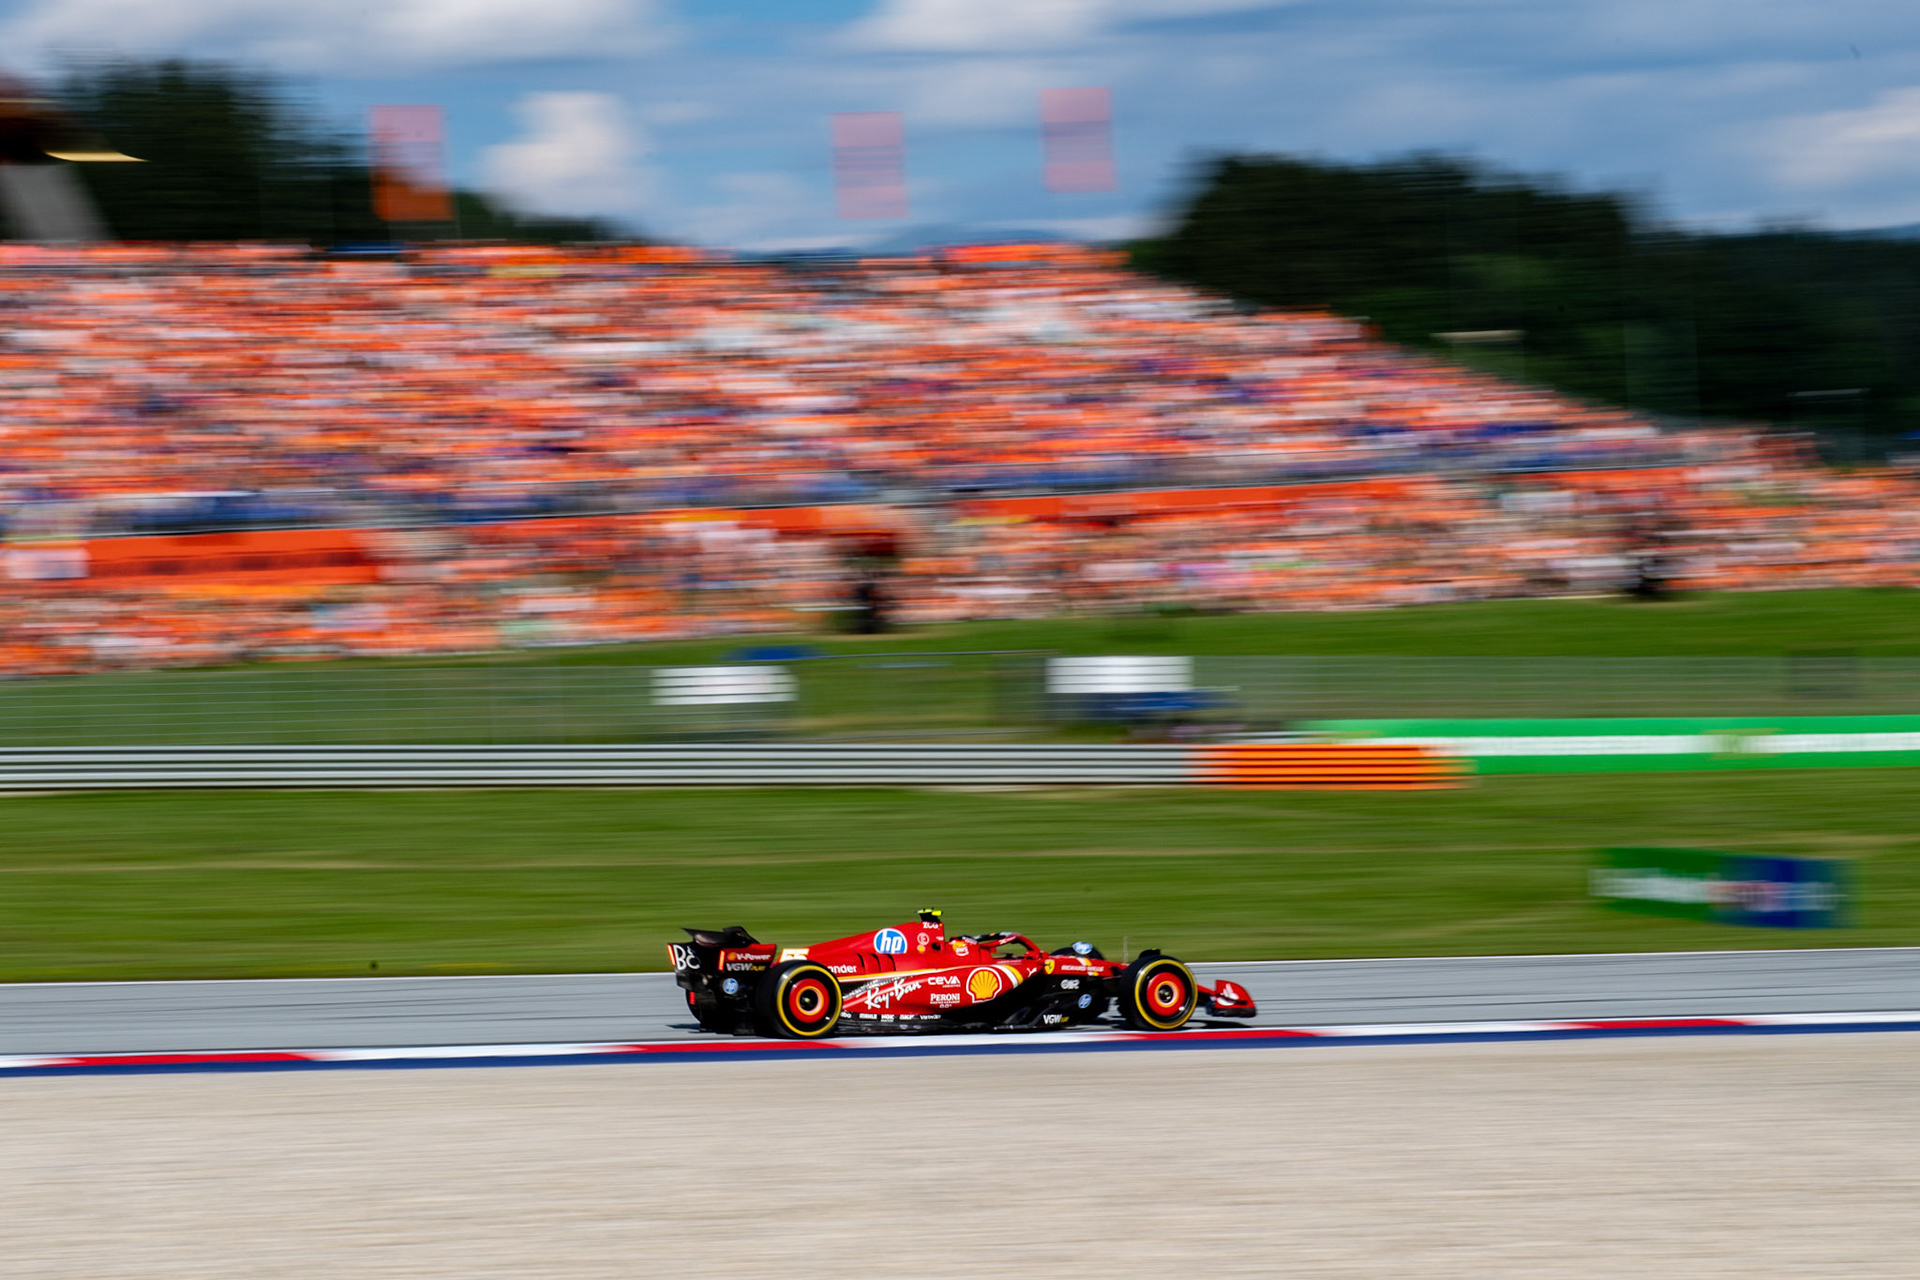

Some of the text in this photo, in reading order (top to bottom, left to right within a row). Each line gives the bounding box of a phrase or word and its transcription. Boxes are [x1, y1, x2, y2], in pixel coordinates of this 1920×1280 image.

[879, 929, 904, 954] hp
[736, 952, 771, 961] V-Power
[726, 962, 753, 972] VGW
[864, 978, 922, 1010] Ray-Ban
[930, 993, 960, 1002] PERONI
[1043, 1013, 1062, 1024] VGW
